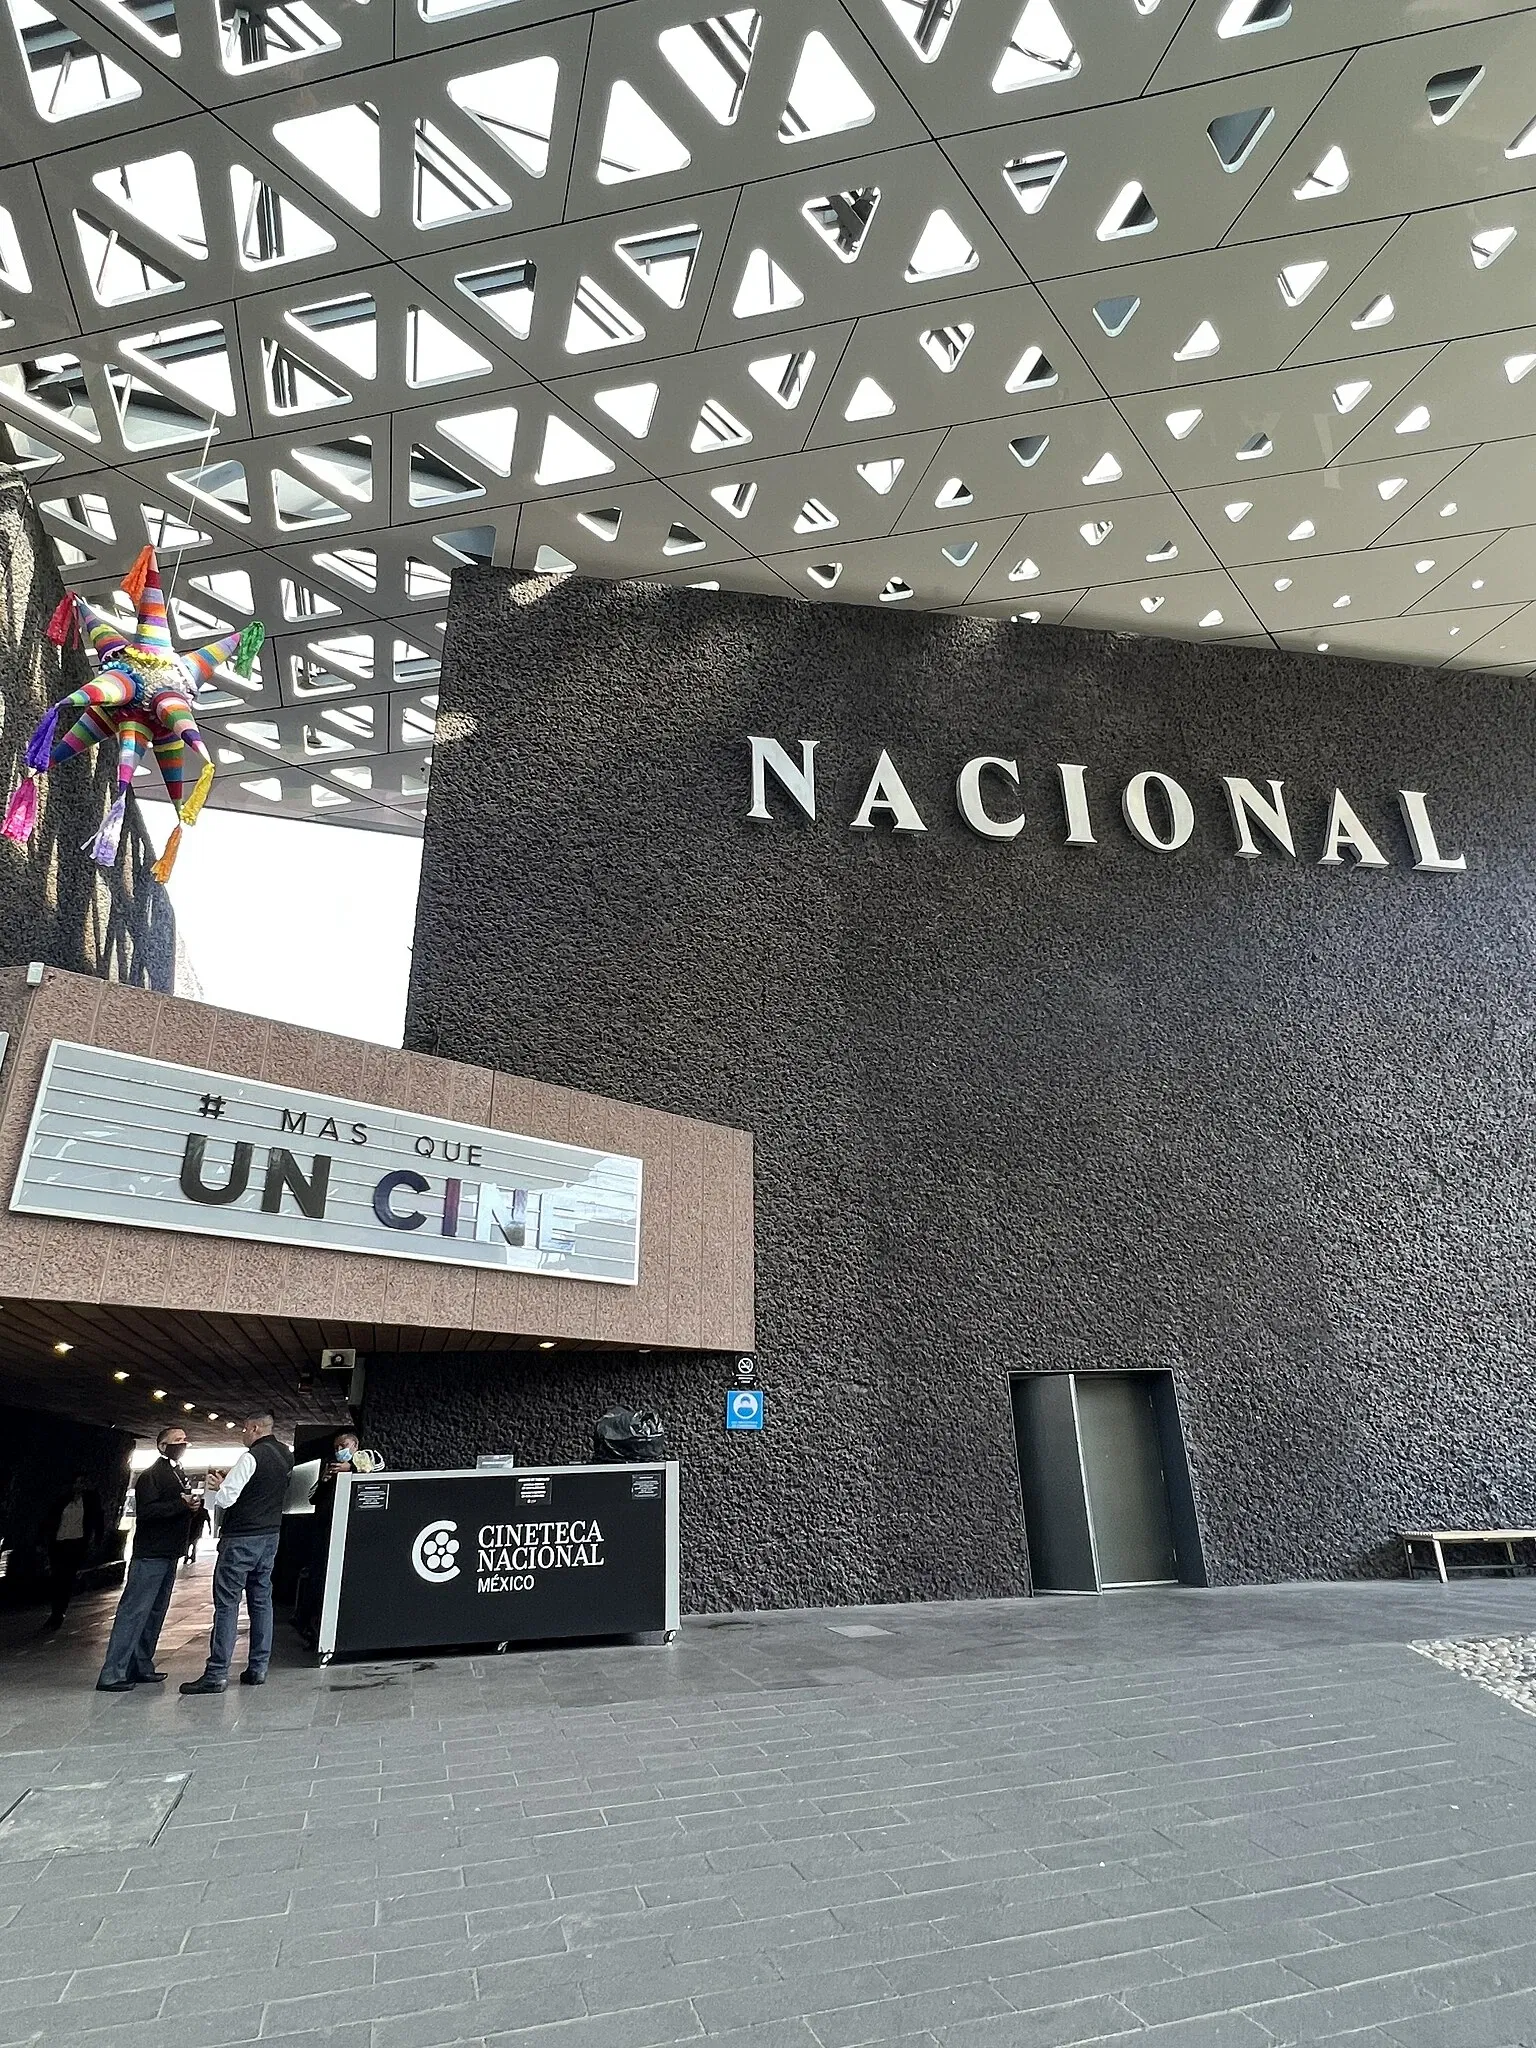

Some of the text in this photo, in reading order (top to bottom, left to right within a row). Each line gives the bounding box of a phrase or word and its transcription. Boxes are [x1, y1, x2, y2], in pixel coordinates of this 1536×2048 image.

[746, 735, 1467, 872] NACIONAL
[281, 1108, 368, 1145] MAS
[415, 1135, 482, 1166] QUE
[179, 1132, 576, 1253] UN CINE
[478, 1520, 605, 1549] CINETECA
[477, 1543, 605, 1573] NACIONAL
[477, 1574, 535, 1594] MÉXICO
